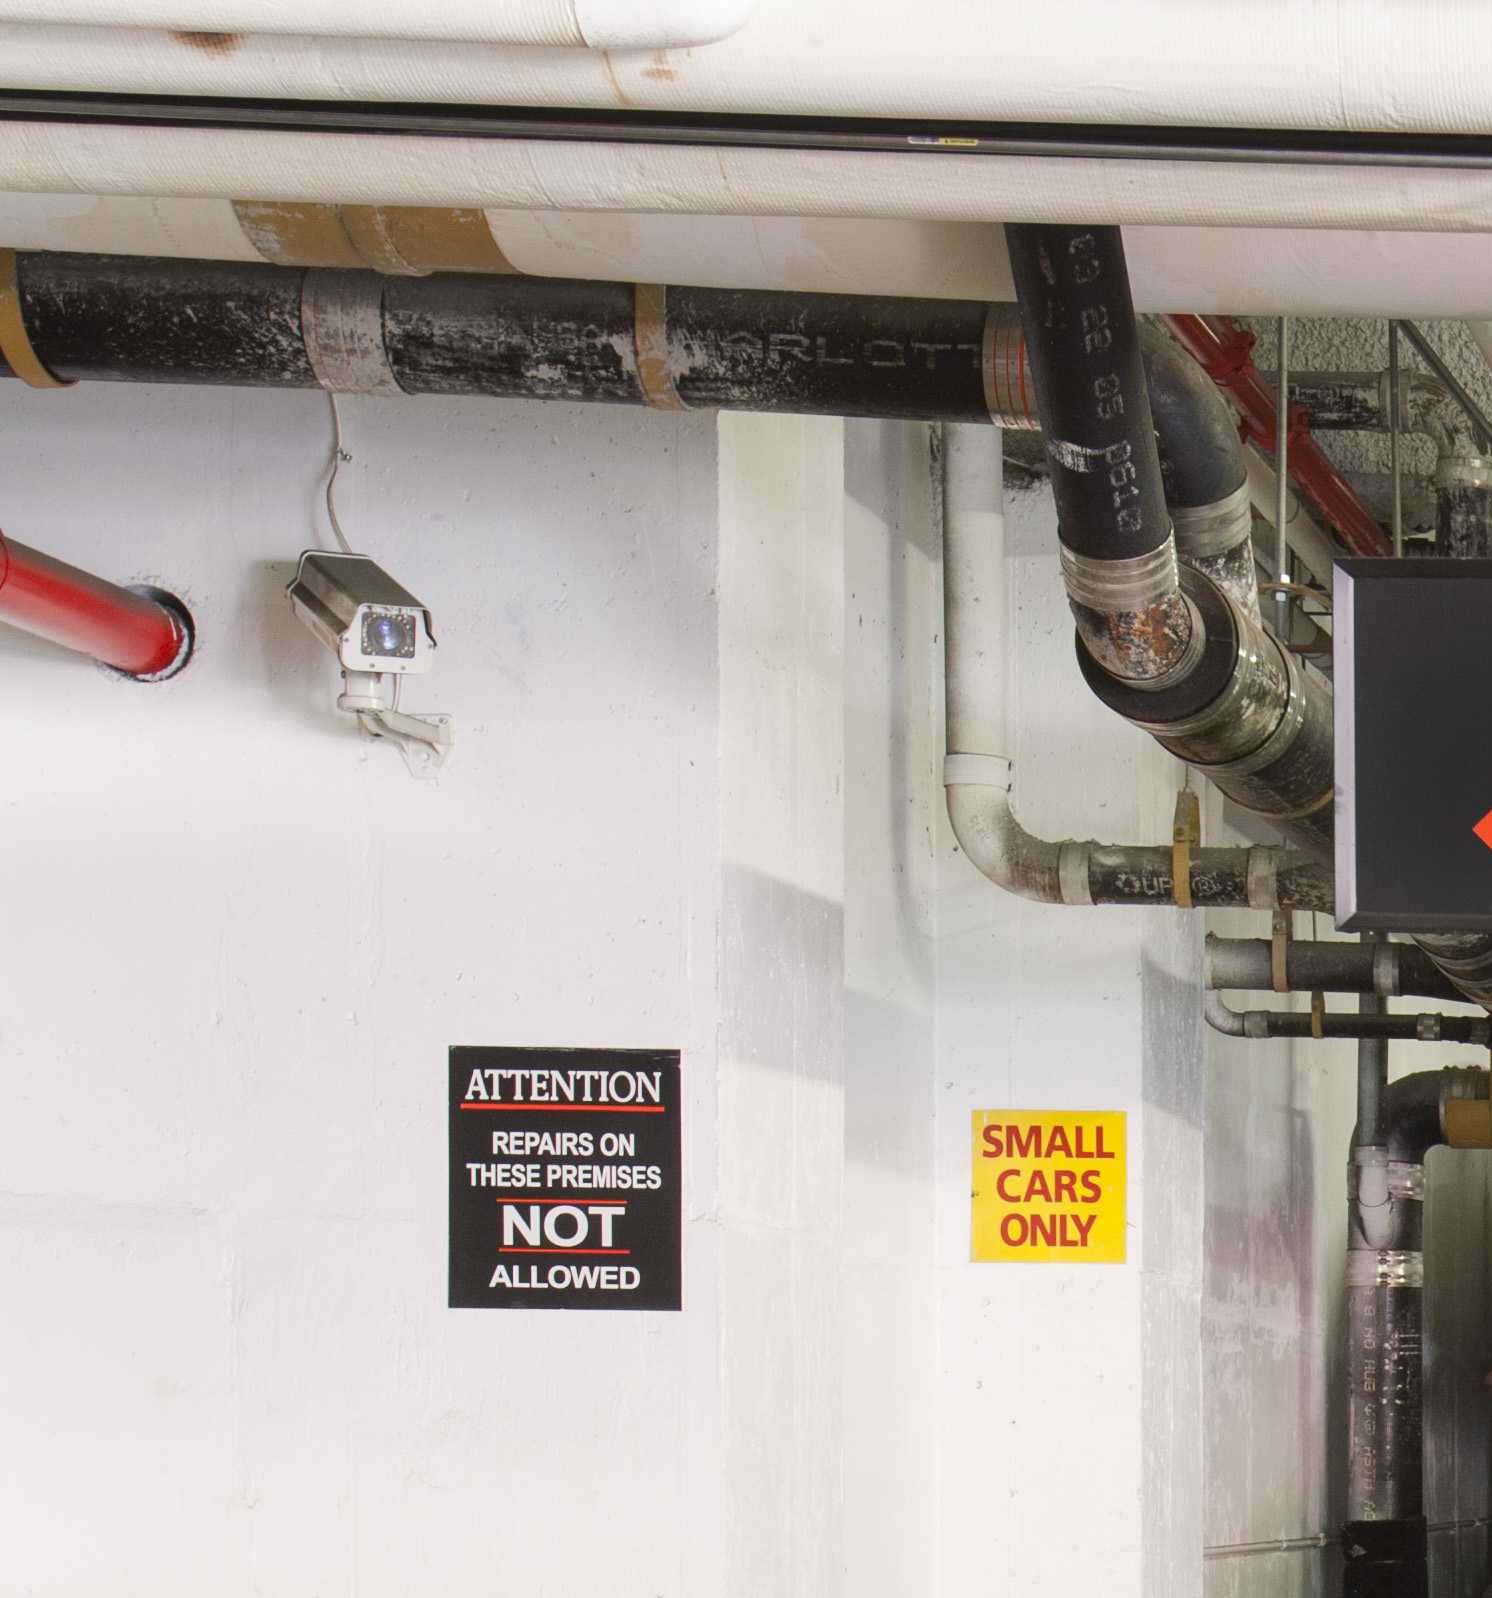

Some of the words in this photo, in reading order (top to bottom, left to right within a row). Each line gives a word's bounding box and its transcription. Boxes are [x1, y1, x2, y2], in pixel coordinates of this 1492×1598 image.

[464, 1068, 662, 1103] ATTENTION
[492, 1131, 594, 1156] REPAIRS
[599, 1132, 635, 1157] ON
[982, 1124, 1116, 1159] SMALL
[466, 1163, 541, 1187] THESE
[546, 1165, 662, 1189] PREMISES
[996, 1168, 1103, 1204] CARS
[503, 1204, 626, 1248] NOT
[1000, 1213, 1098, 1248] ONLY
[488, 1265, 641, 1289] ALLOWED
